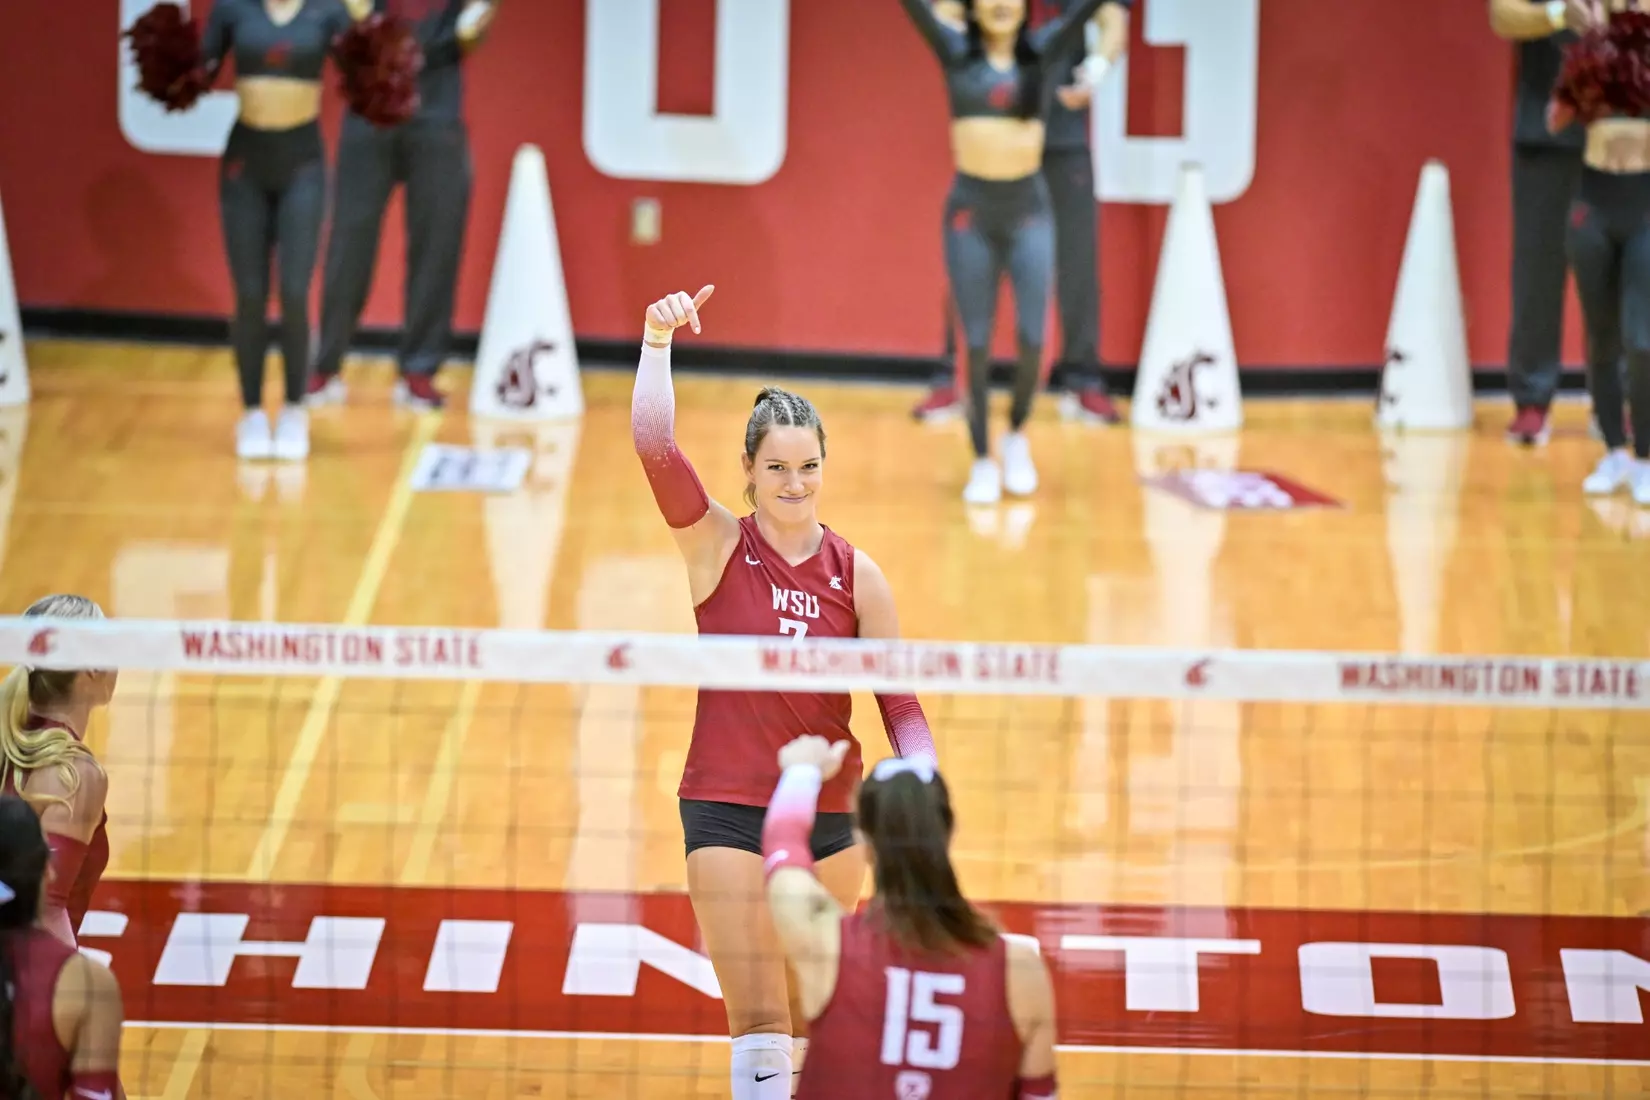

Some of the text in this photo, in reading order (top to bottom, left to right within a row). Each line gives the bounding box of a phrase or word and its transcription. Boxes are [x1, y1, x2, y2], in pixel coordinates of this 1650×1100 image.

[770, 583, 820, 619] WSU
[181, 629, 484, 669] WASHINGTON STATE
[761, 645, 1062, 684] WASHINGTON STATE
[1339, 660, 1640, 699] WASHINGTON STATE
[880, 965, 966, 1071] 15
